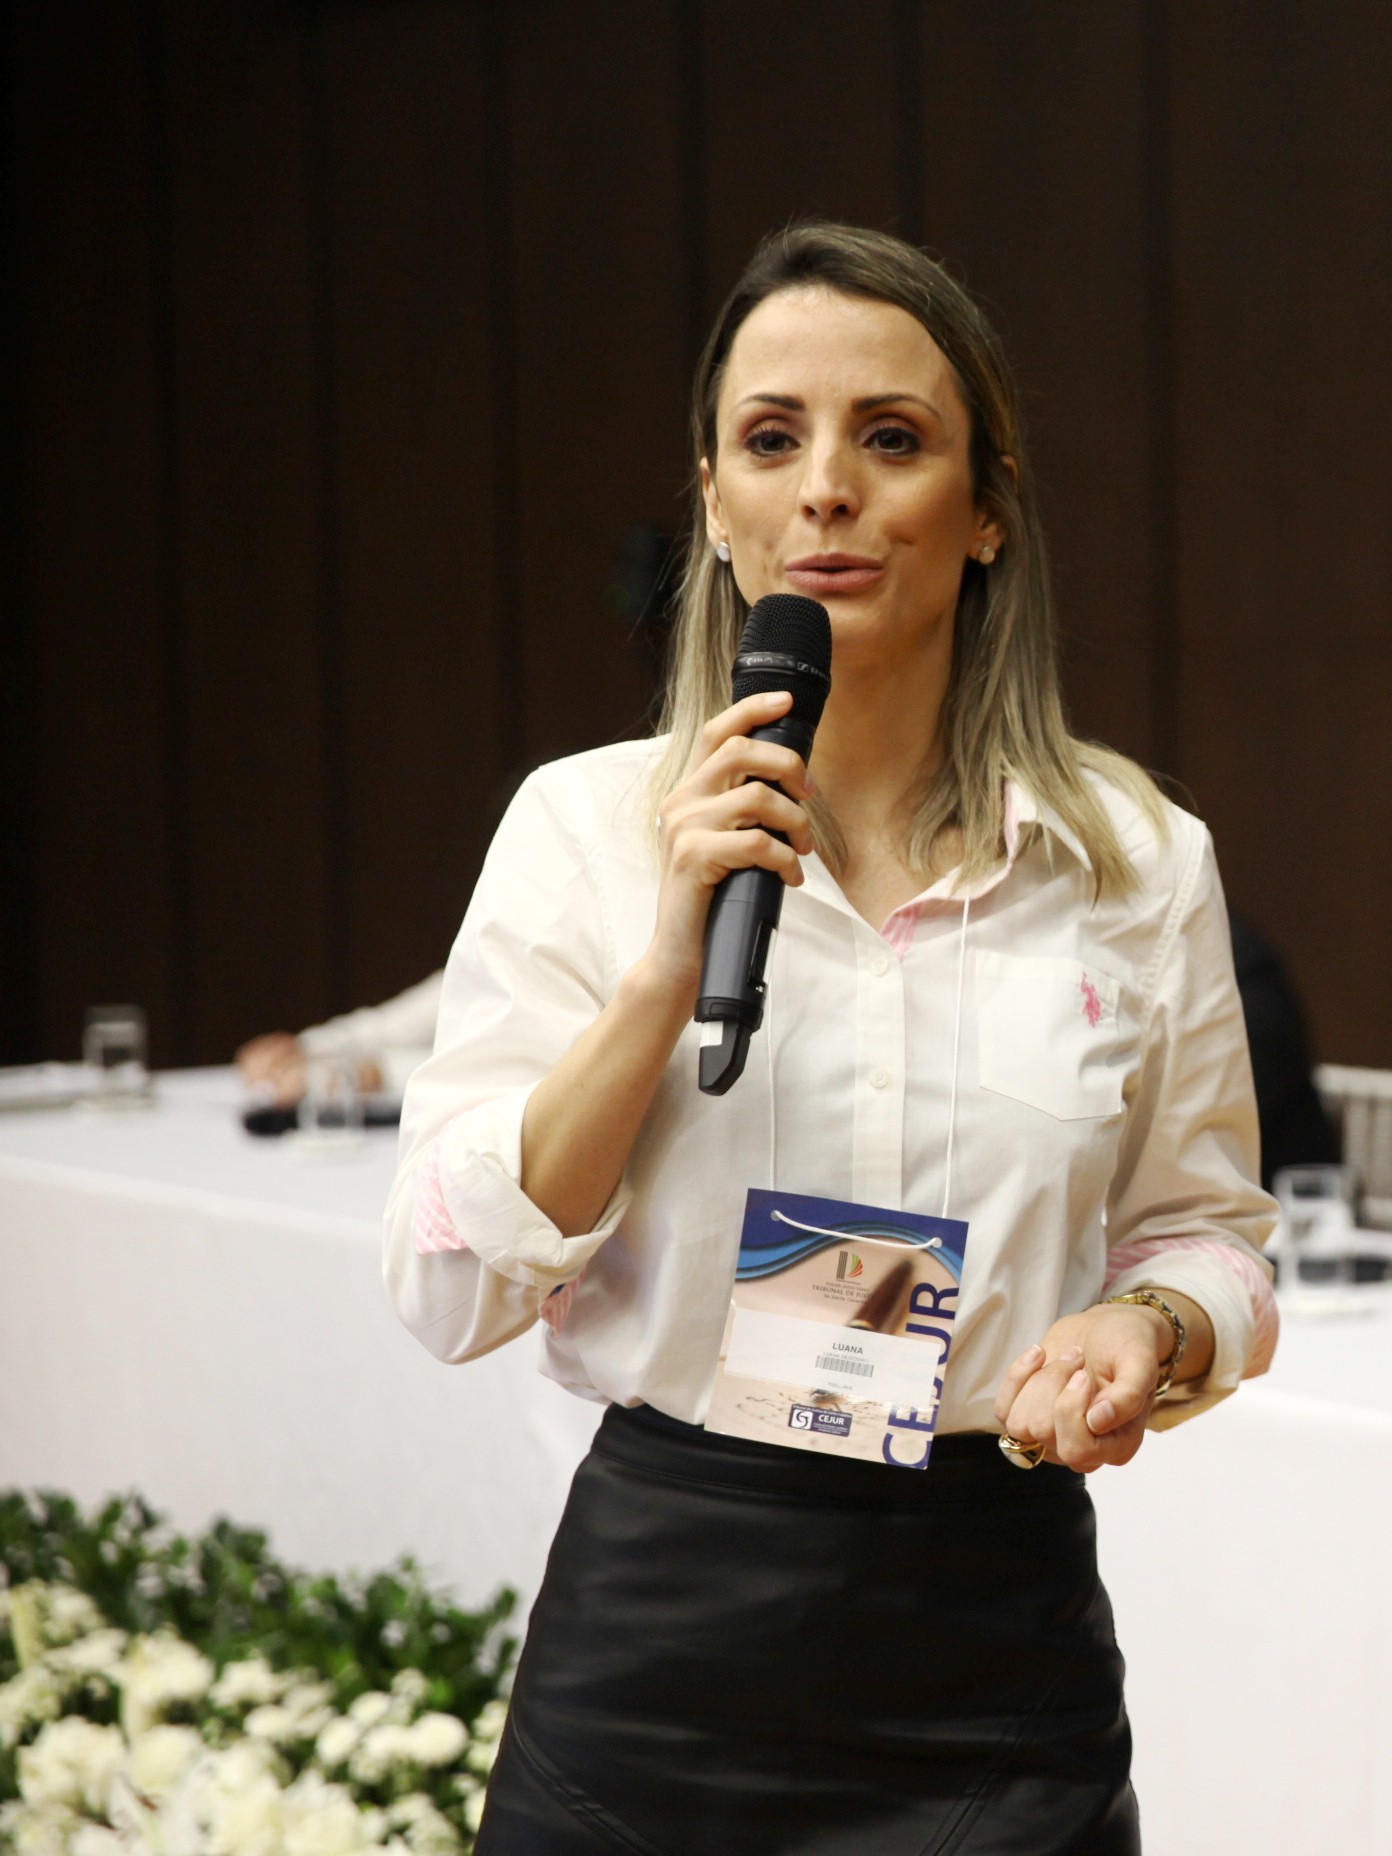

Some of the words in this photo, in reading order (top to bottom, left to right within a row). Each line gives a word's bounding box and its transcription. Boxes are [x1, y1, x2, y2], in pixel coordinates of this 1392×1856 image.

[812, 1284, 844, 1295] TRIBUNAL
[832, 1342, 863, 1354] LUANA
[818, 1414, 845, 1425] CEJUR
